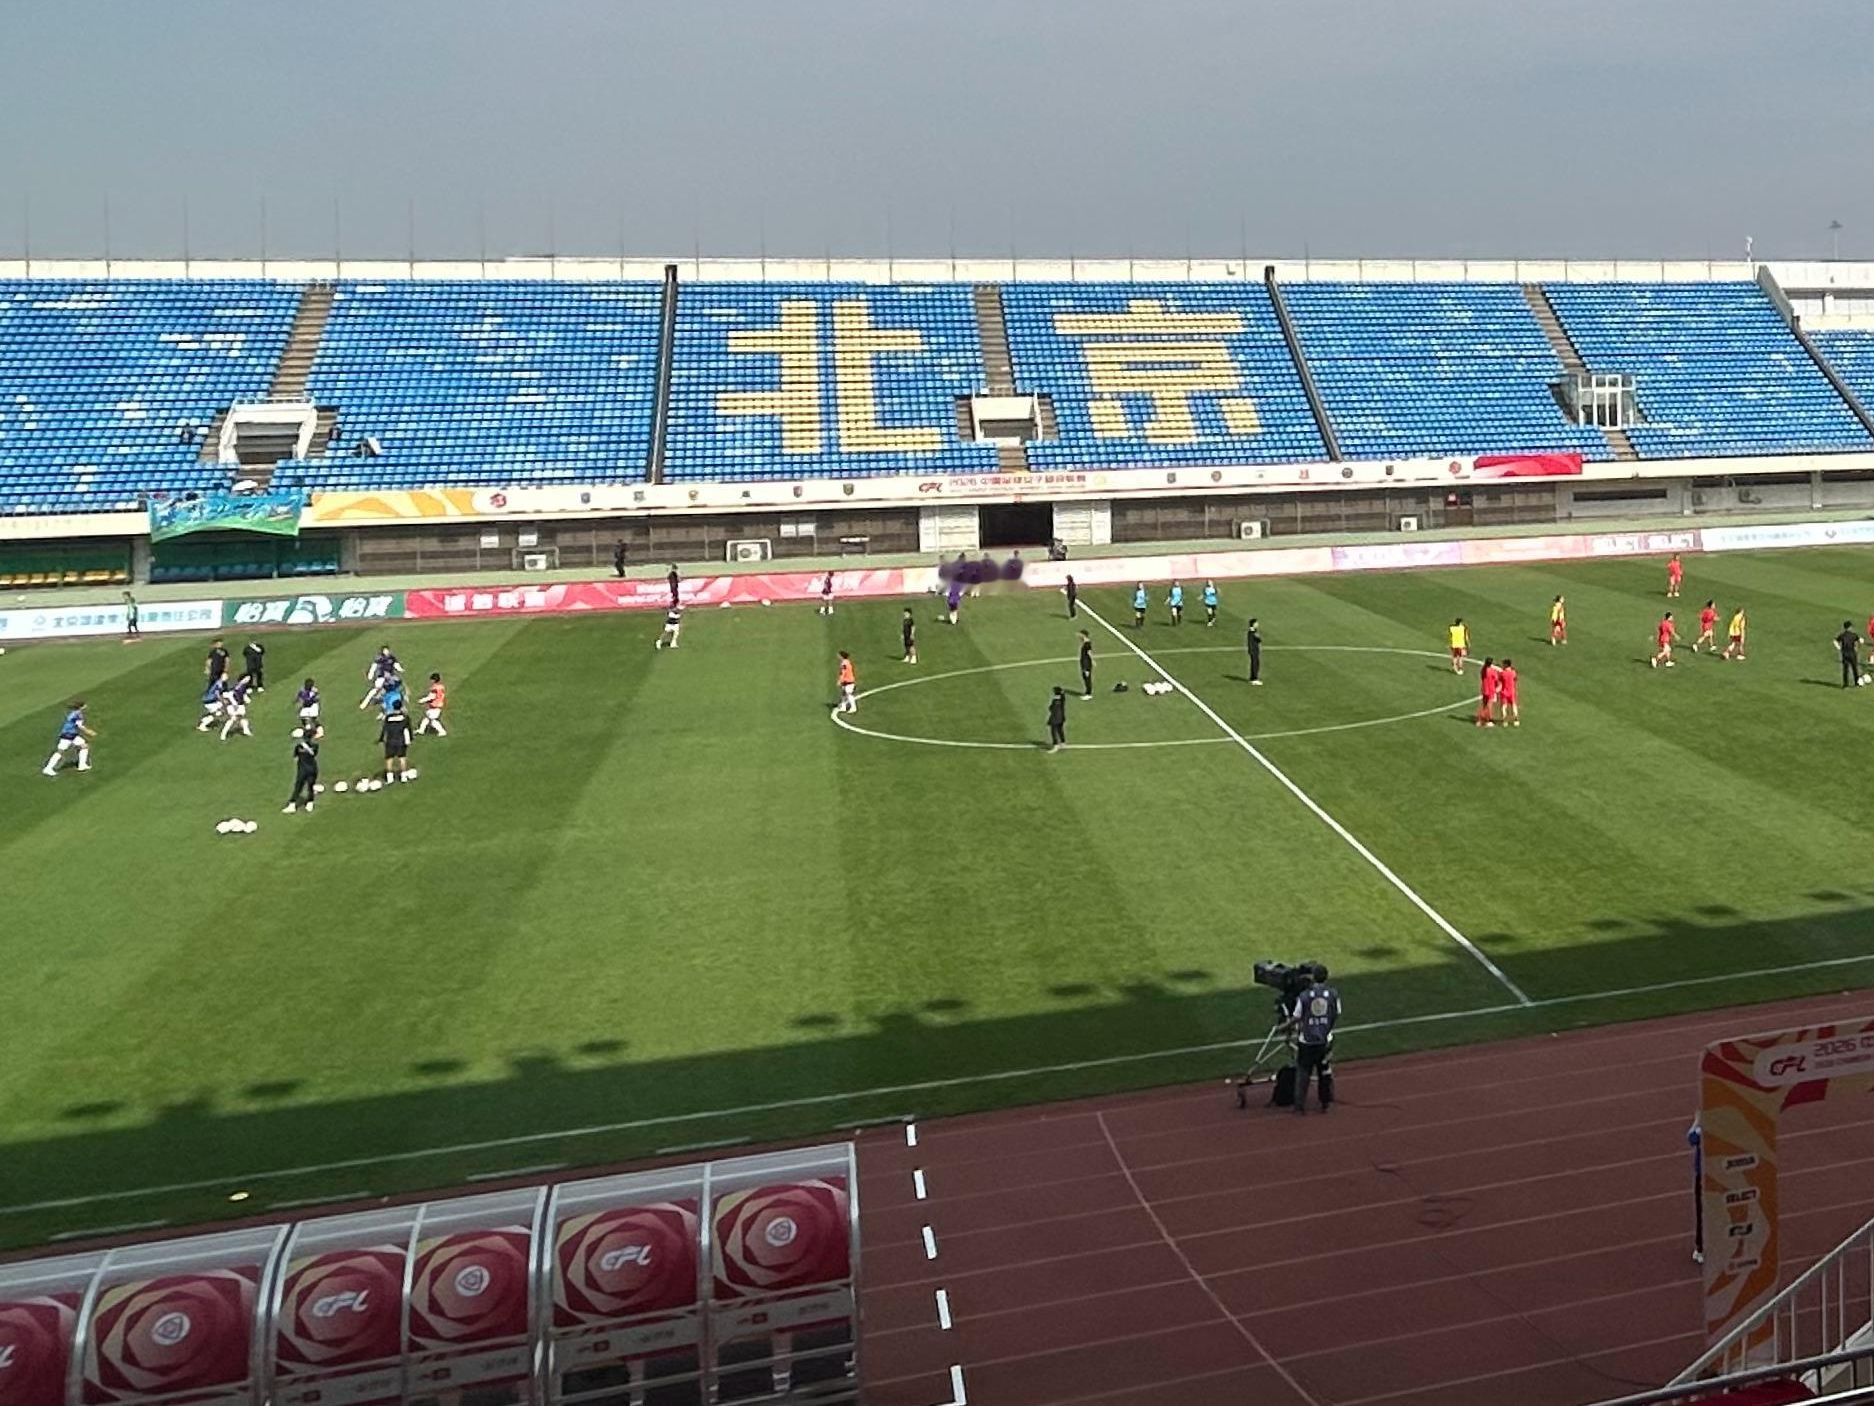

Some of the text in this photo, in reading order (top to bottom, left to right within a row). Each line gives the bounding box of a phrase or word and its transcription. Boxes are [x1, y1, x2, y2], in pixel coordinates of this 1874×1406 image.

[717, 299, 1262, 454] 北京
[600, 1244, 653, 1273] CFL
[312, 1289, 370, 1318] CFL
